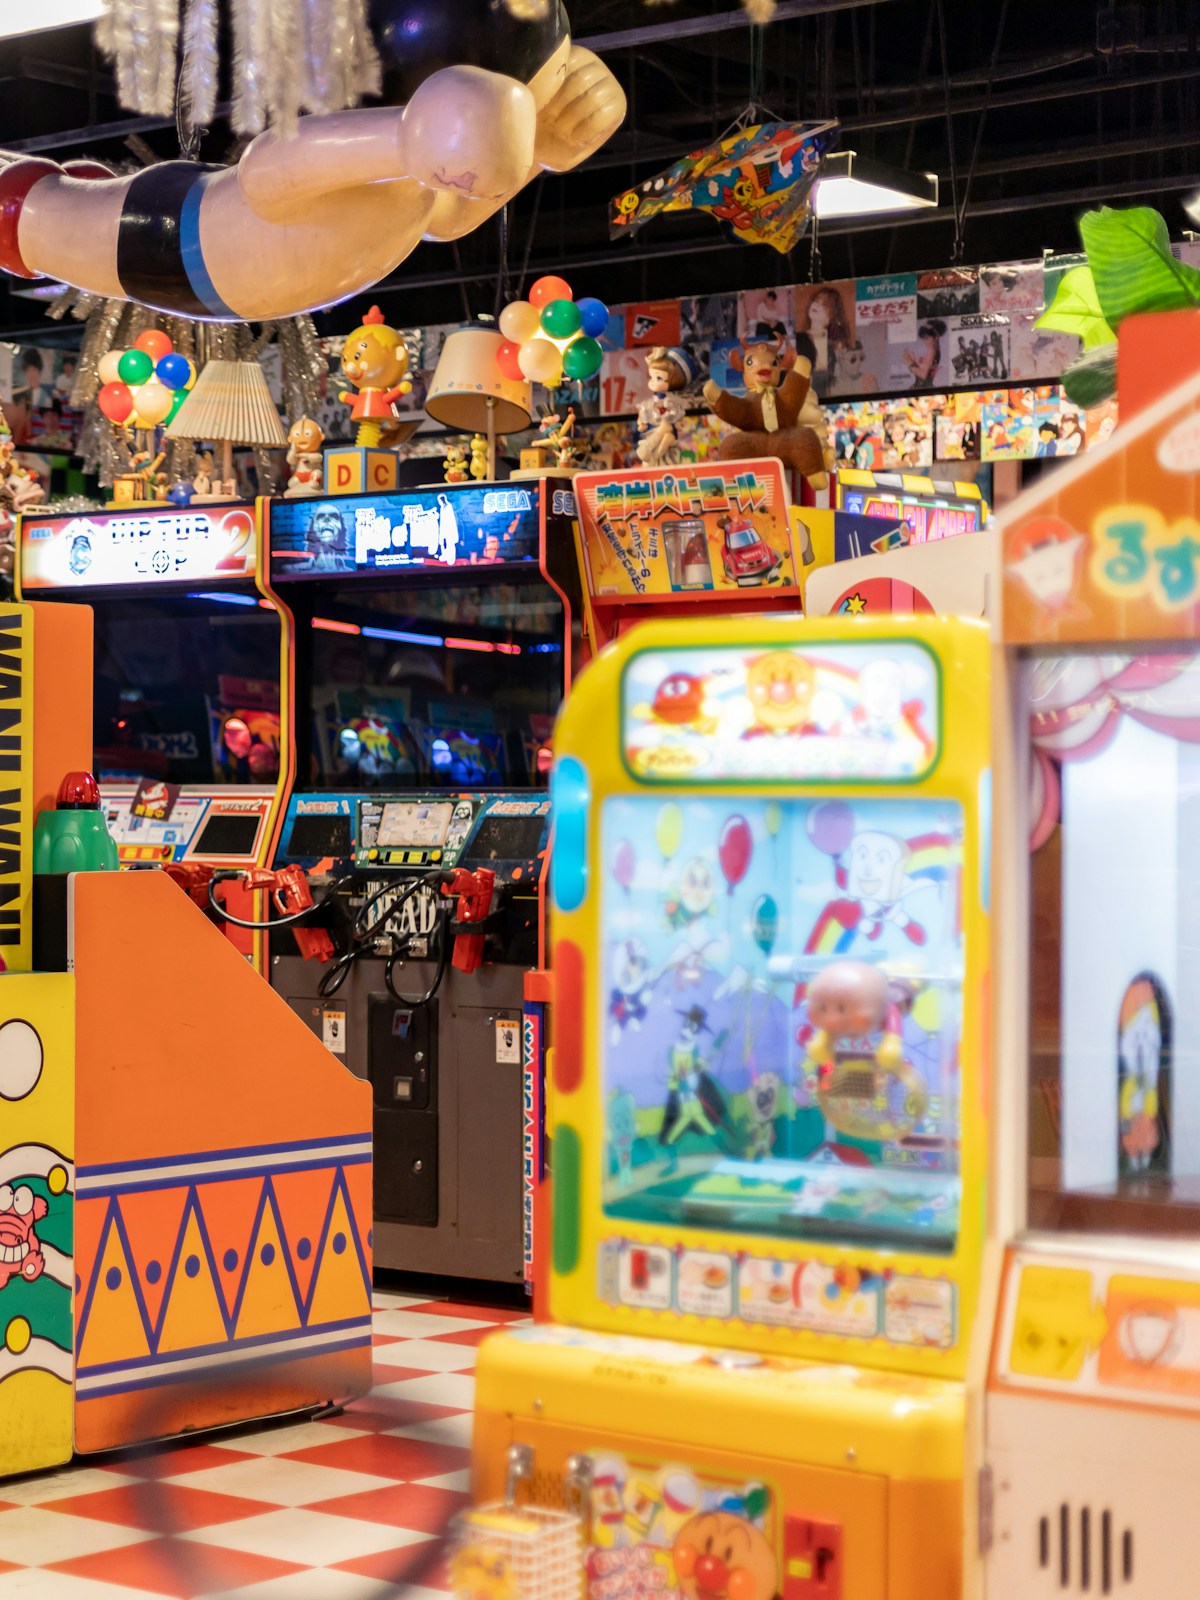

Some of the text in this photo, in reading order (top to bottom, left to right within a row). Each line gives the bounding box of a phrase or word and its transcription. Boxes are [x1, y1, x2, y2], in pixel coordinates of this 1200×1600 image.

[337, 464, 351, 486] D
[374, 463, 389, 481] C
[484, 489, 532, 514] SEGA
[215, 510, 253, 573] 2
[297, 800, 340, 814] AGENT
[487, 801, 535, 814] AGENT
